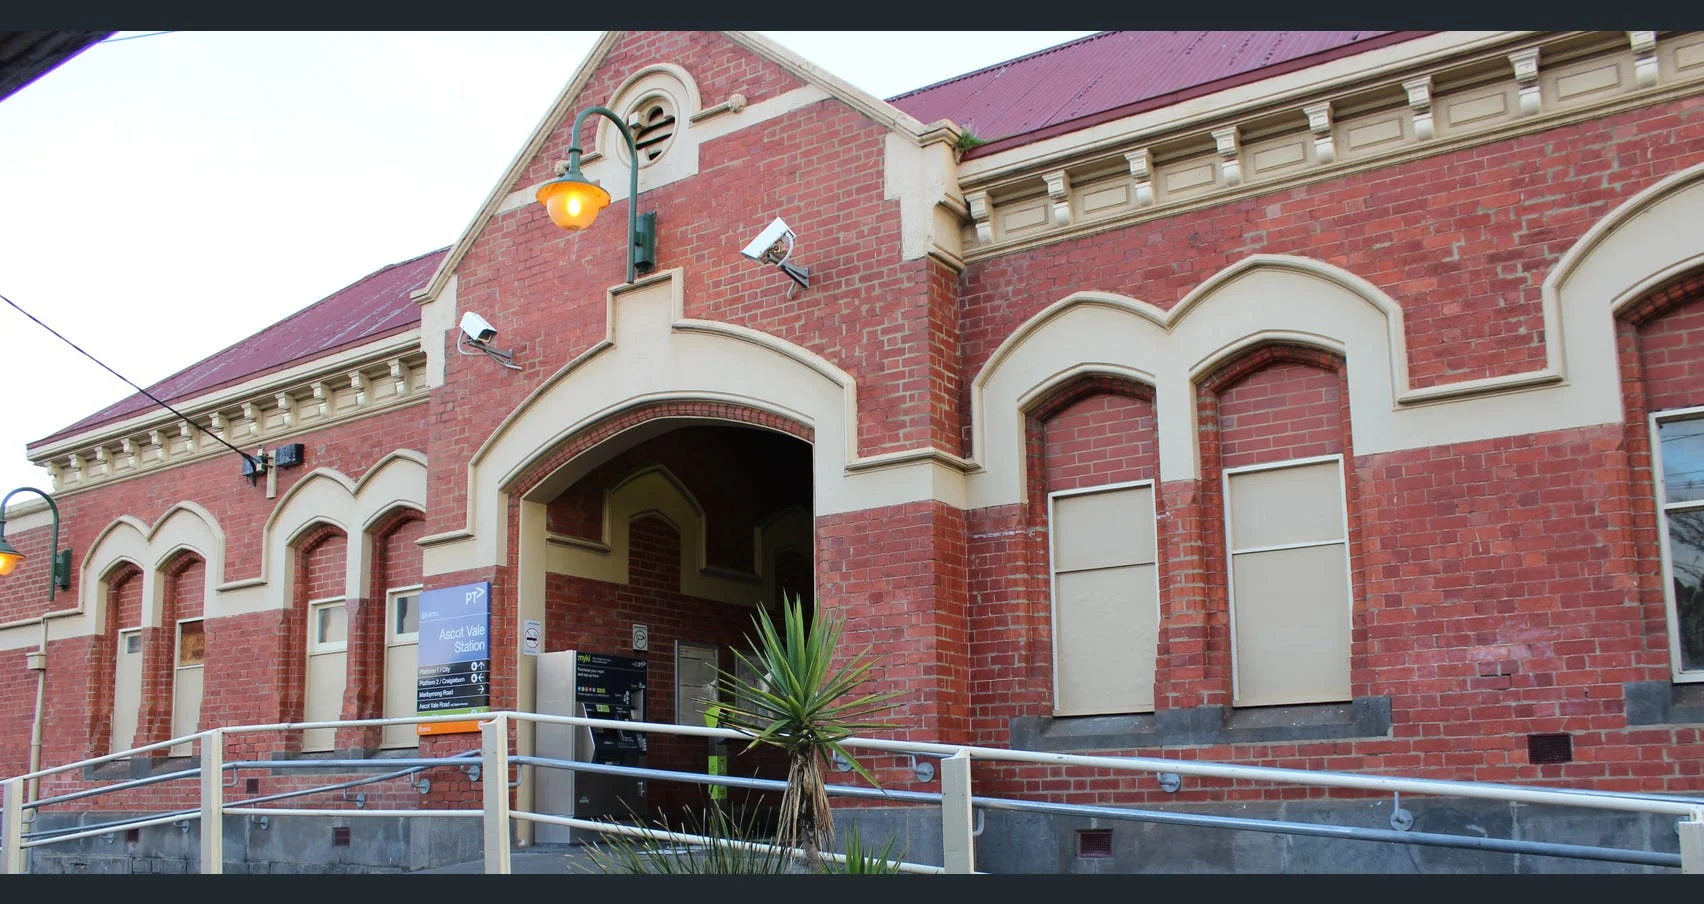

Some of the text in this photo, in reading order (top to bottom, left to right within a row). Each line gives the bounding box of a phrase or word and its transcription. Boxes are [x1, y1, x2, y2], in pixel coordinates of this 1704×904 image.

[439, 624, 485, 640] Ascot Vale
[454, 640, 485, 653] Station
[577, 654, 591, 663] myki
